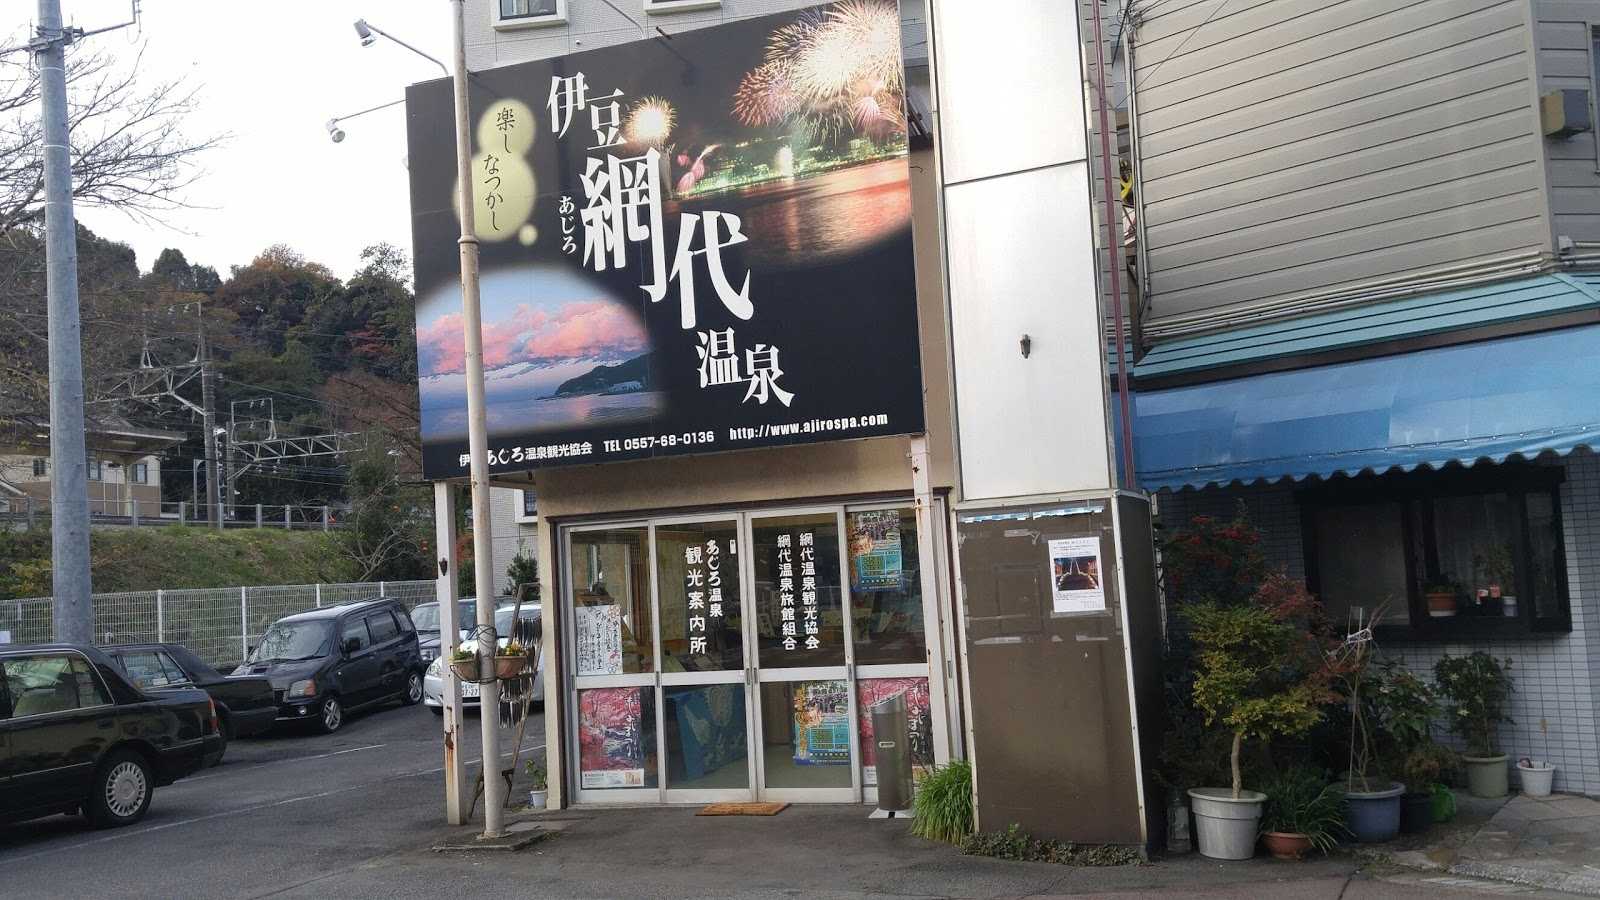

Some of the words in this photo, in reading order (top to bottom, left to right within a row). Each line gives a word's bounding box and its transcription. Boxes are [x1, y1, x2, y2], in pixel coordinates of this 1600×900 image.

[496, 107, 516, 154] 楽し
[547, 72, 626, 150] 伊豆
[484, 154, 504, 231] なつかし
[559, 196, 577, 254] あじろ
[580, 147, 755, 329] 網代
[696, 327, 795, 408] 温泉
[459, 441, 593, 467] 伊あじろ温泉観光協会
[604, 439, 621, 452] TEL
[624, 430, 715, 450] 0557-68-0136
[729, 413, 889, 441] http://www.ajirospa.com
[685, 546, 707, 655] 観光案内所
[706, 539, 723, 617] あじろ温泉
[777, 534, 798, 651] 網代温泉旅館組合
[799, 532, 820, 650] 網代温泉観光協会
